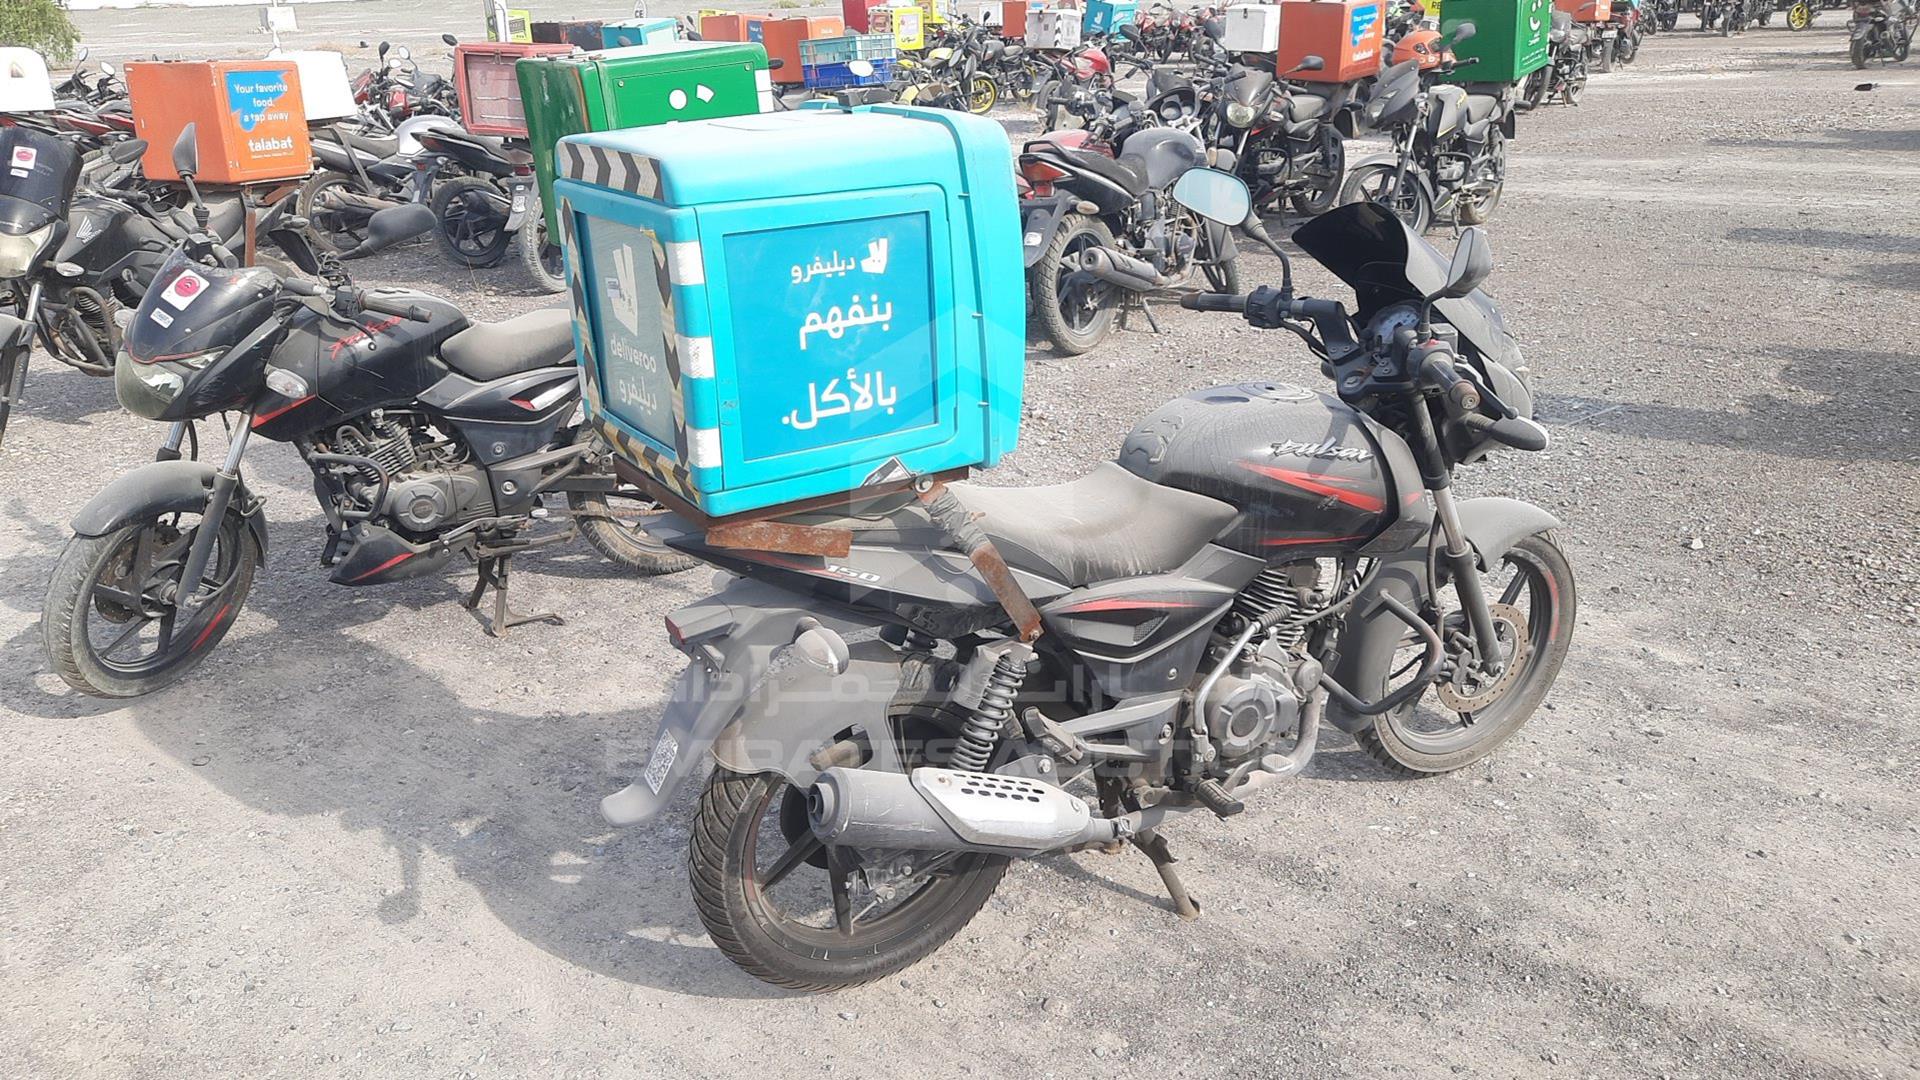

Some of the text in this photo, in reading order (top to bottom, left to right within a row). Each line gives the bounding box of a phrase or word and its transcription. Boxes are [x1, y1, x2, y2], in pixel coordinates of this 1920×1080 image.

[233, 82, 288, 94] Your favorite
[243, 112, 289, 124] a tap away
[248, 136, 293, 152] talabat
[790, 250, 857, 285] ديليفرو
[799, 293, 893, 351] بنفهم
[610, 333, 657, 373] deliveroo
[619, 375, 658, 416] ديليفرو
[827, 564, 881, 582] 150
